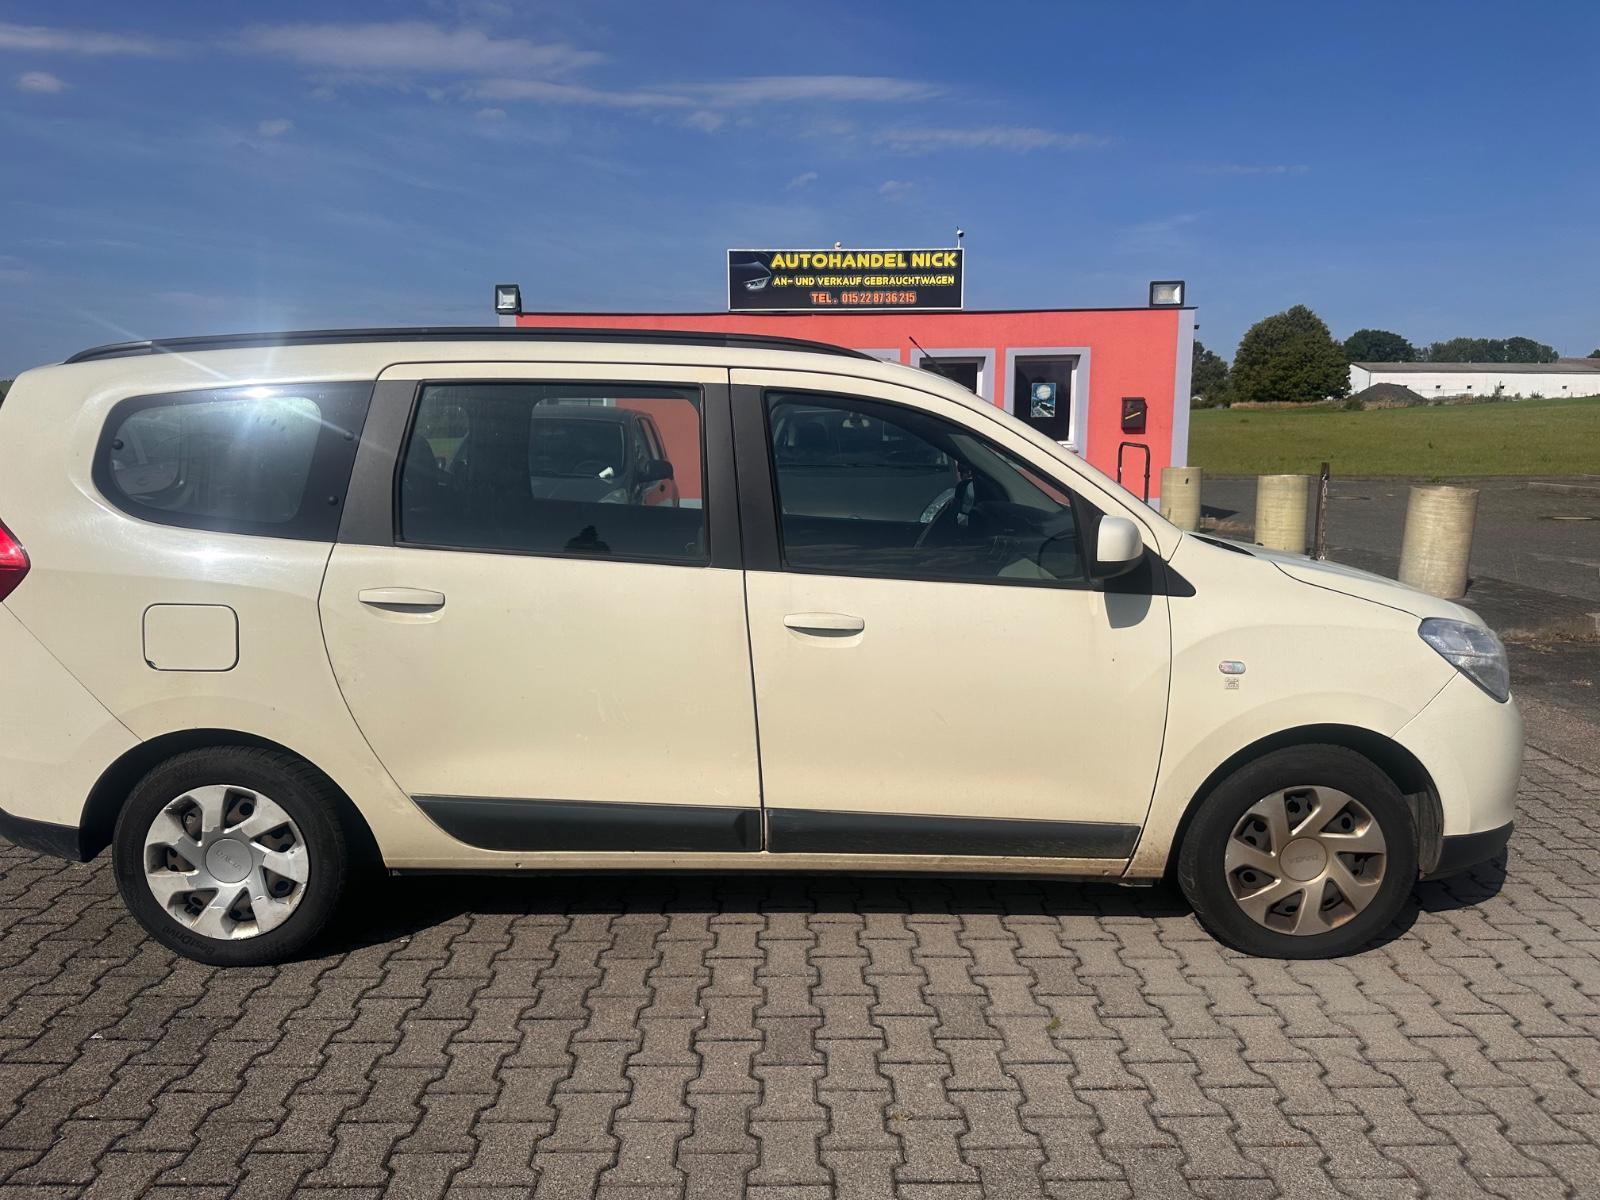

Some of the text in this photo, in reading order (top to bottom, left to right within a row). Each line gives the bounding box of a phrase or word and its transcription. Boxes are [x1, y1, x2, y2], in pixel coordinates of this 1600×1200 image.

[771, 252, 958, 268] AUTOHANDEL NICK
[773, 275, 955, 286] AN- UND VERKAUF GEBRAUCHTWAGEN
[811, 293, 837, 304] TEL.
